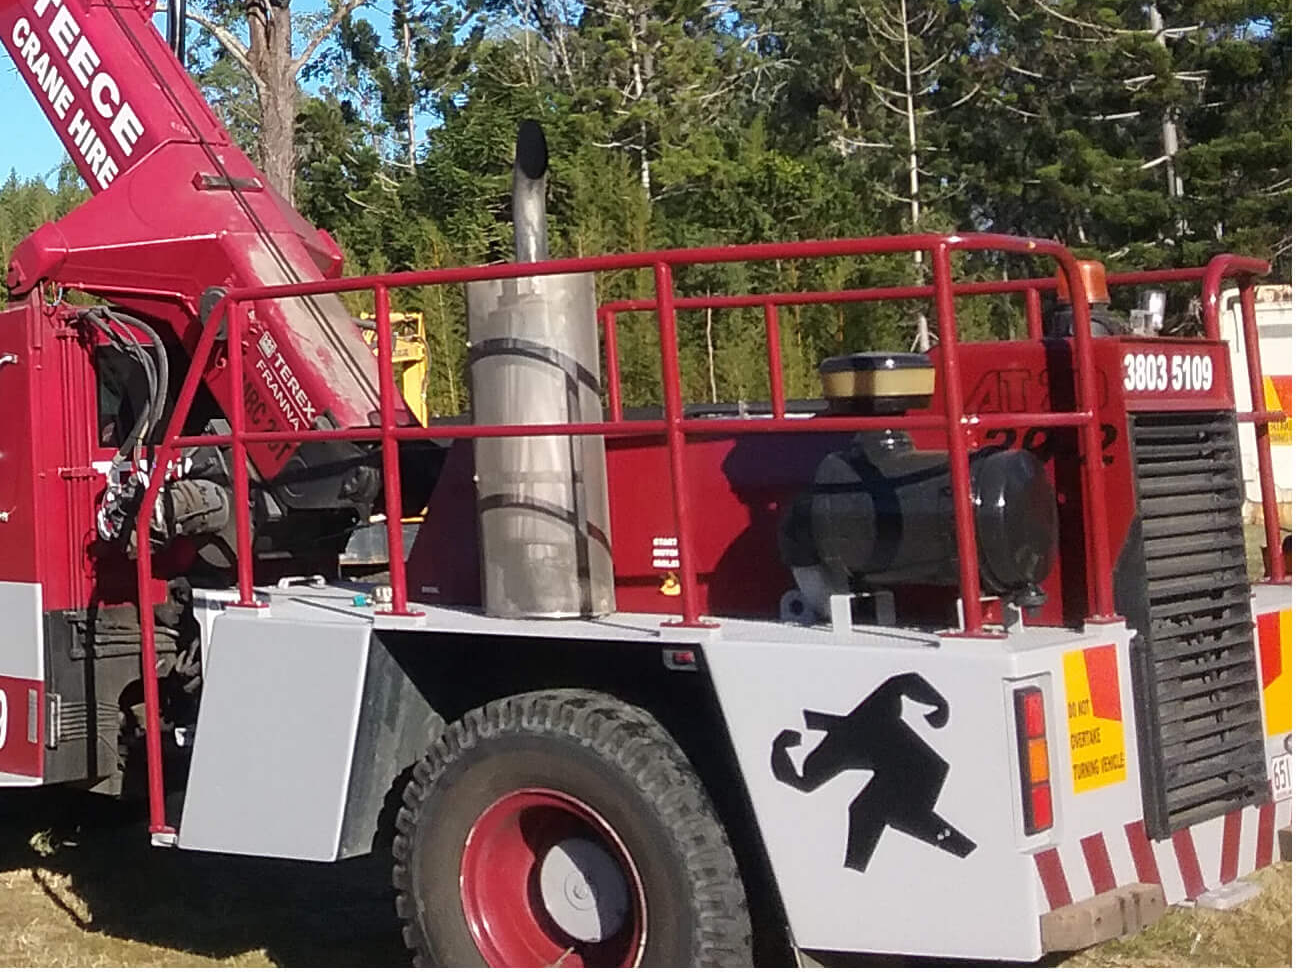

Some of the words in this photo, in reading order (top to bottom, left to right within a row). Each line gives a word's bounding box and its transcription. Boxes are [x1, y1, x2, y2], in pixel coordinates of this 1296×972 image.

[12, 17, 75, 120] CRANE
[67, 108, 120, 190] HIRE
[273, 352, 317, 421] TEREX
[1123, 353, 1168, 391] 3803
[1171, 354, 1213, 391] 5109
[255, 359, 300, 432] FRANNA
[1067, 701, 1077, 718] DO
[1078, 698, 1090, 717] NOT
[1070, 727, 1101, 750] OVERTAKE
[1072, 758, 1100, 780] TURNING
[1100, 751, 1125, 773] VEHICLE
